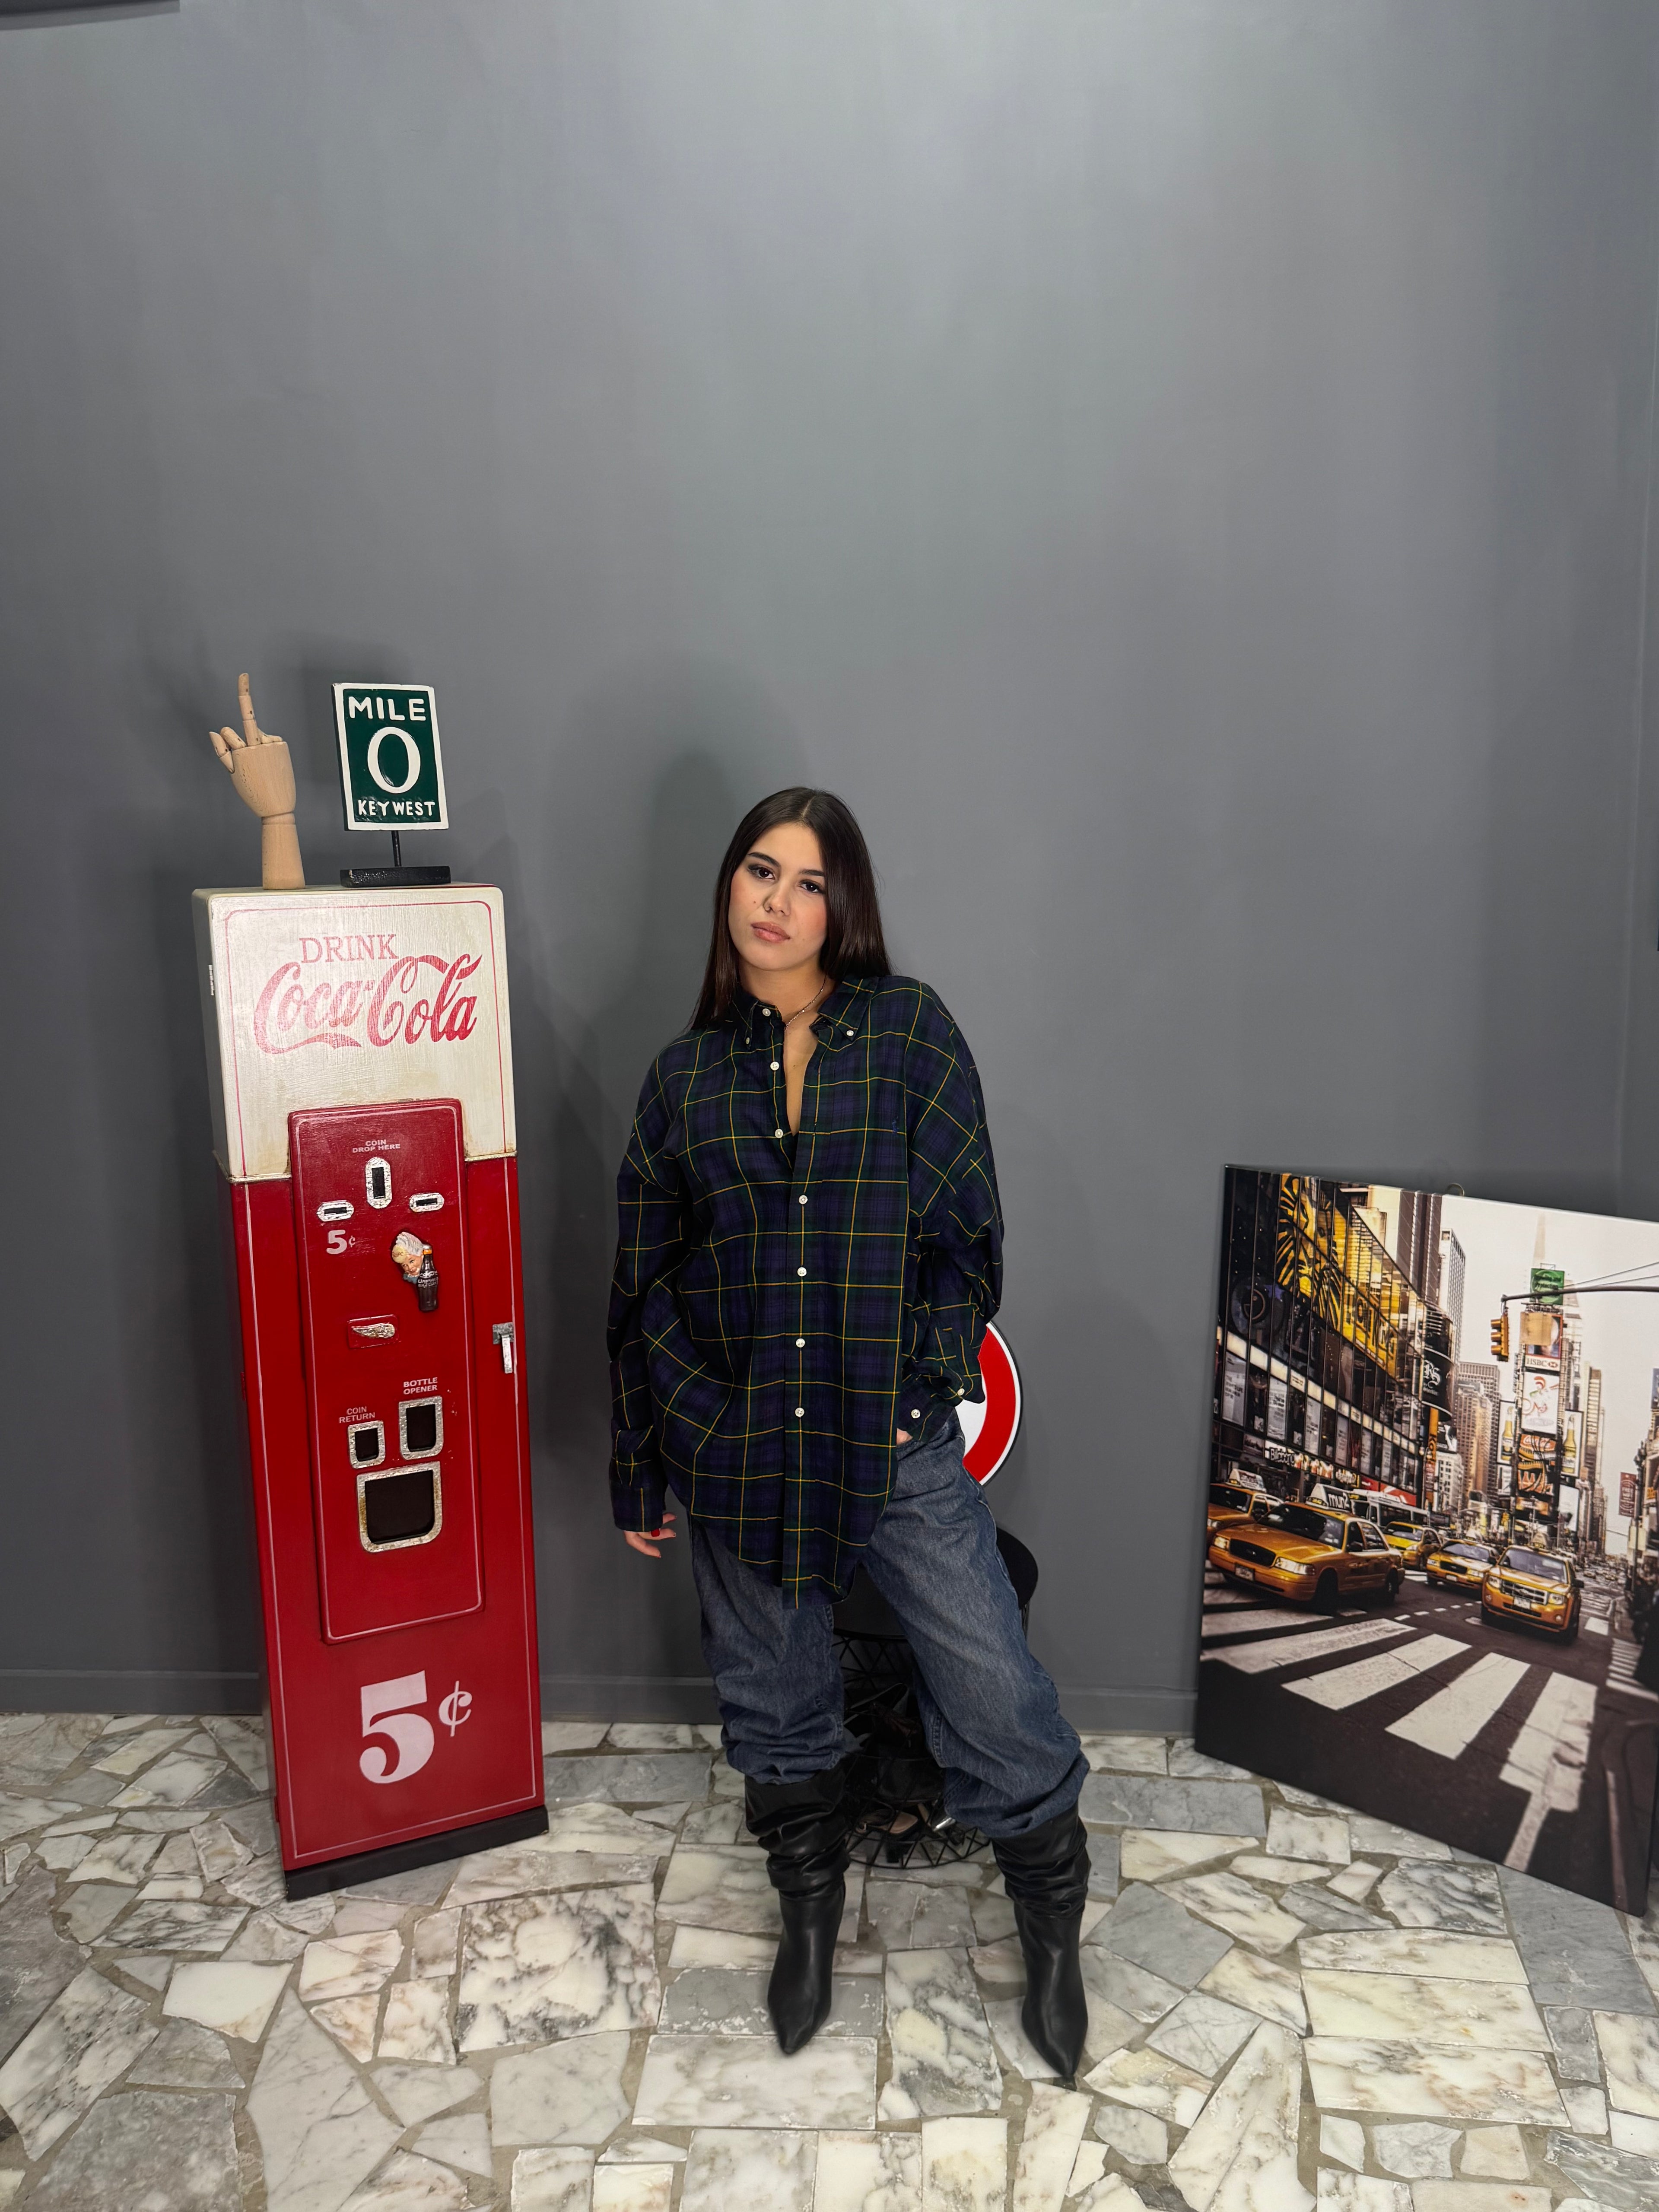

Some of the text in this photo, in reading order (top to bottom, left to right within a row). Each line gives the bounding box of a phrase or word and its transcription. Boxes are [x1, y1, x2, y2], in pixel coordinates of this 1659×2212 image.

[348, 696, 426, 721] MILE
[367, 726, 421, 794] 0
[358, 800, 435, 816] KEY WEST
[299, 934, 399, 963] DRINK
[253, 953, 483, 1055] Coca-Cola
[1526, 1357, 1547, 1367] HSBC
[404, 1377, 438, 1388] BOTTLE
[404, 1385, 438, 1395] OPENER
[339, 1412, 375, 1423] RETURN
[347, 1406, 367, 1415] COIN
[1328, 1492, 1350, 1510] mun2
